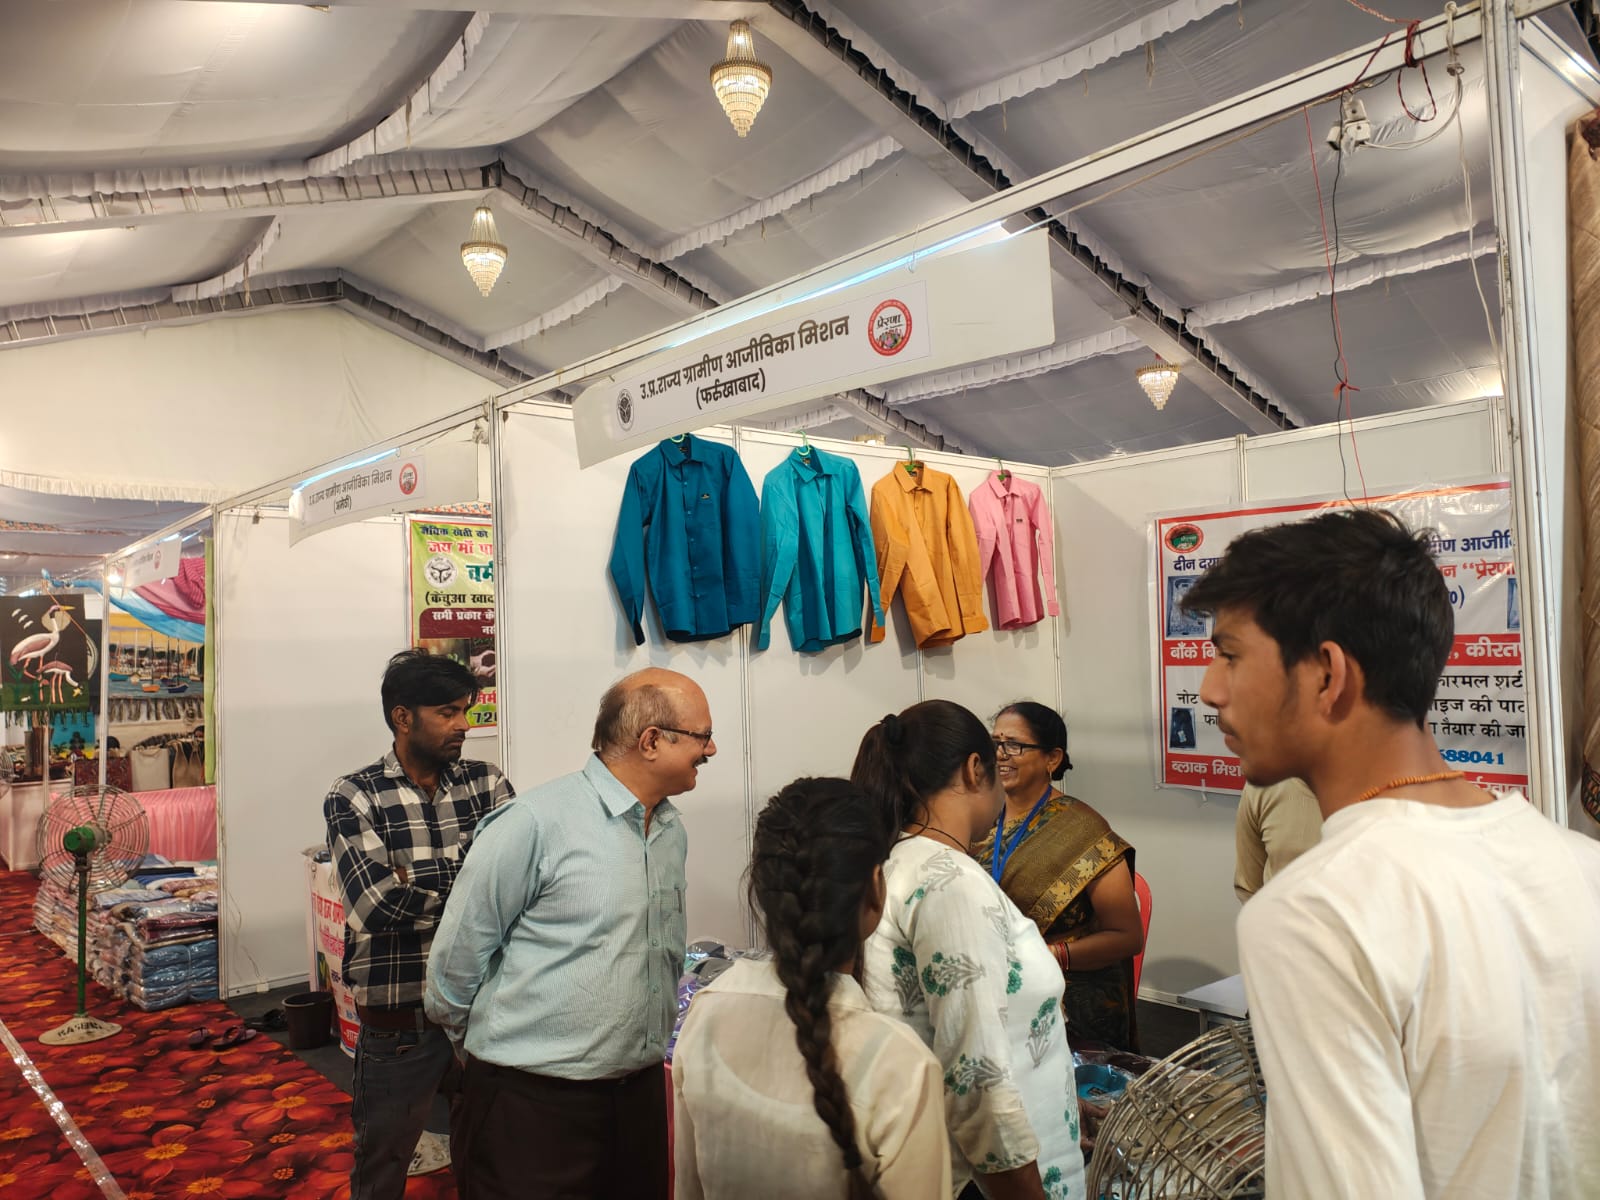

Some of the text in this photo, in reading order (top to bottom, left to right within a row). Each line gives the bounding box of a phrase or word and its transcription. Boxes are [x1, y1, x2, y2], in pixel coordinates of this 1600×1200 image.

[682, 353, 723, 385] ग्रामीण
[726, 332, 795, 370] आजीविका
[798, 316, 850, 349] मिशन
[1173, 555, 1195, 571] दीन
[1465, 636, 1521, 658] कीरत
[1468, 694, 1493, 713] की
[1441, 716, 1476, 736] तैयार
[1480, 719, 1501, 737] की
